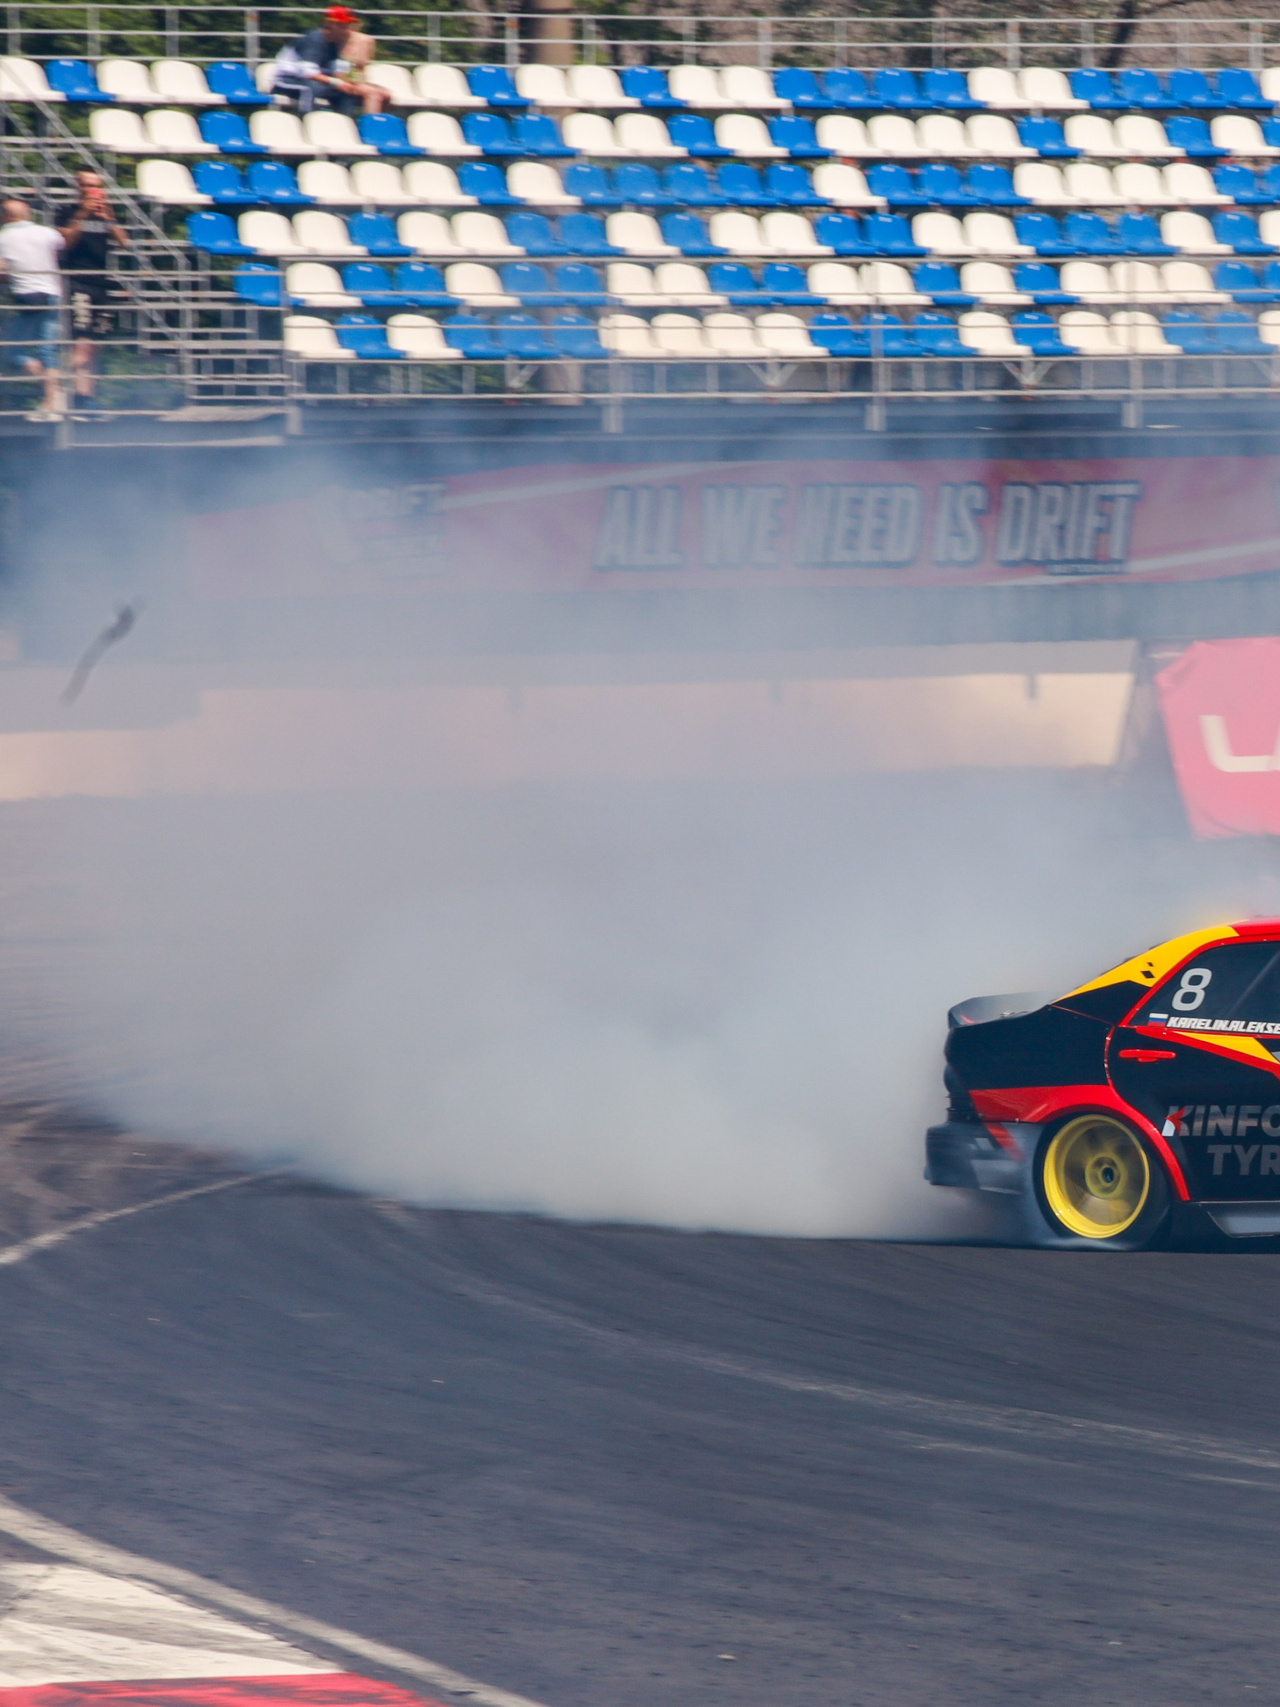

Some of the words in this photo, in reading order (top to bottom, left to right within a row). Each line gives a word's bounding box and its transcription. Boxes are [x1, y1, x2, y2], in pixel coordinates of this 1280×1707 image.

[592, 485, 684, 568] ALL
[701, 484, 787, 566] WE
[797, 483, 921, 567] NEED
[933, 482, 989, 566] IS
[996, 480, 1141, 566] DRIFT
[1171, 967, 1213, 1011] 8
